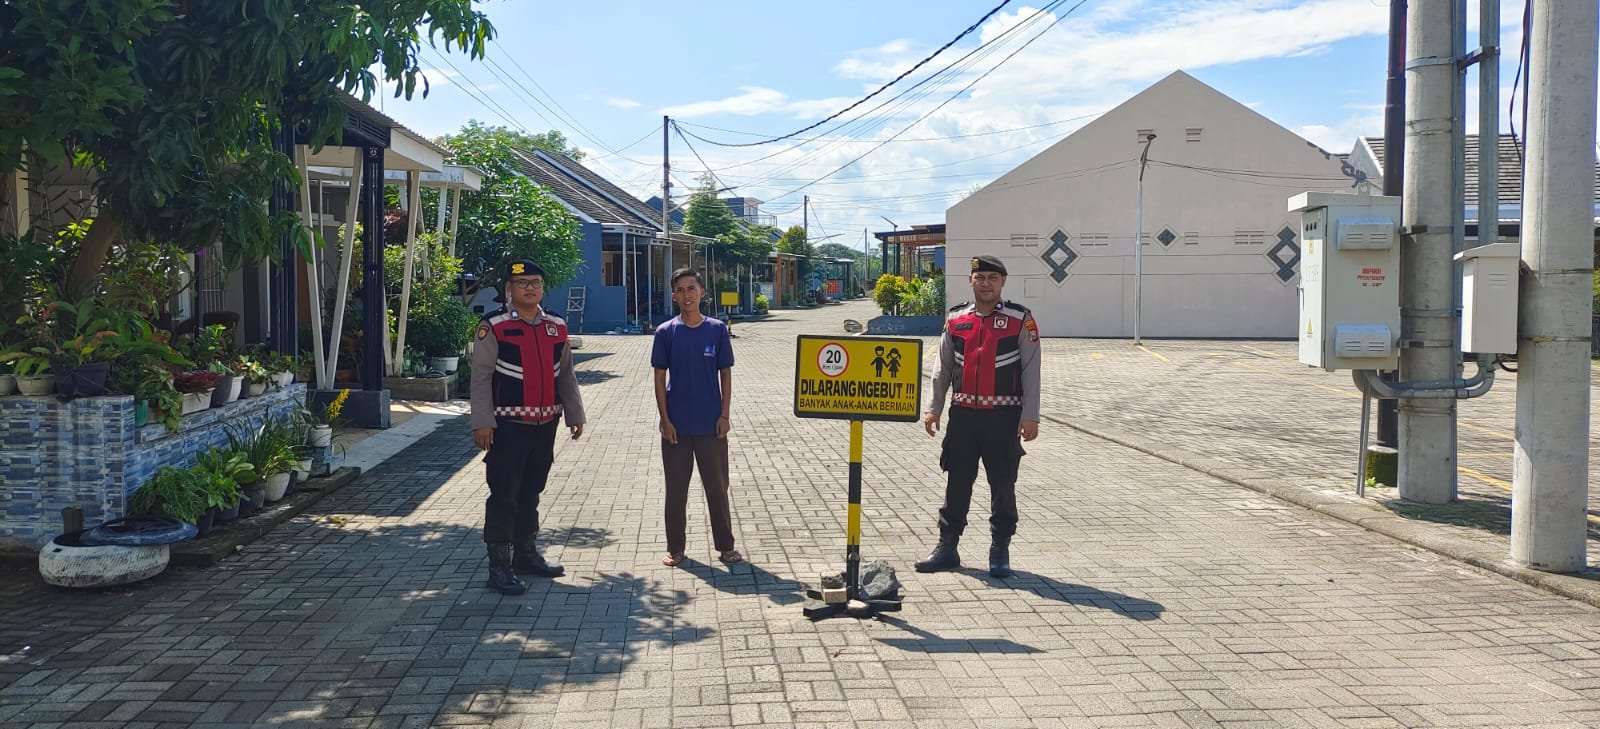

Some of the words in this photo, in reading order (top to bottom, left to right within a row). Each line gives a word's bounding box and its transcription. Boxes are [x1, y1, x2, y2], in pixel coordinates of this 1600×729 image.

[826, 350, 841, 363] 20
[801, 379, 856, 397] DILARANG
[858, 381, 902, 399] NGEBUT
[905, 383, 915, 400] !!!
[800, 398, 831, 408] BANYAK
[832, 400, 878, 410] ANAK-ANAK
[880, 402, 914, 411] BERMAIN
